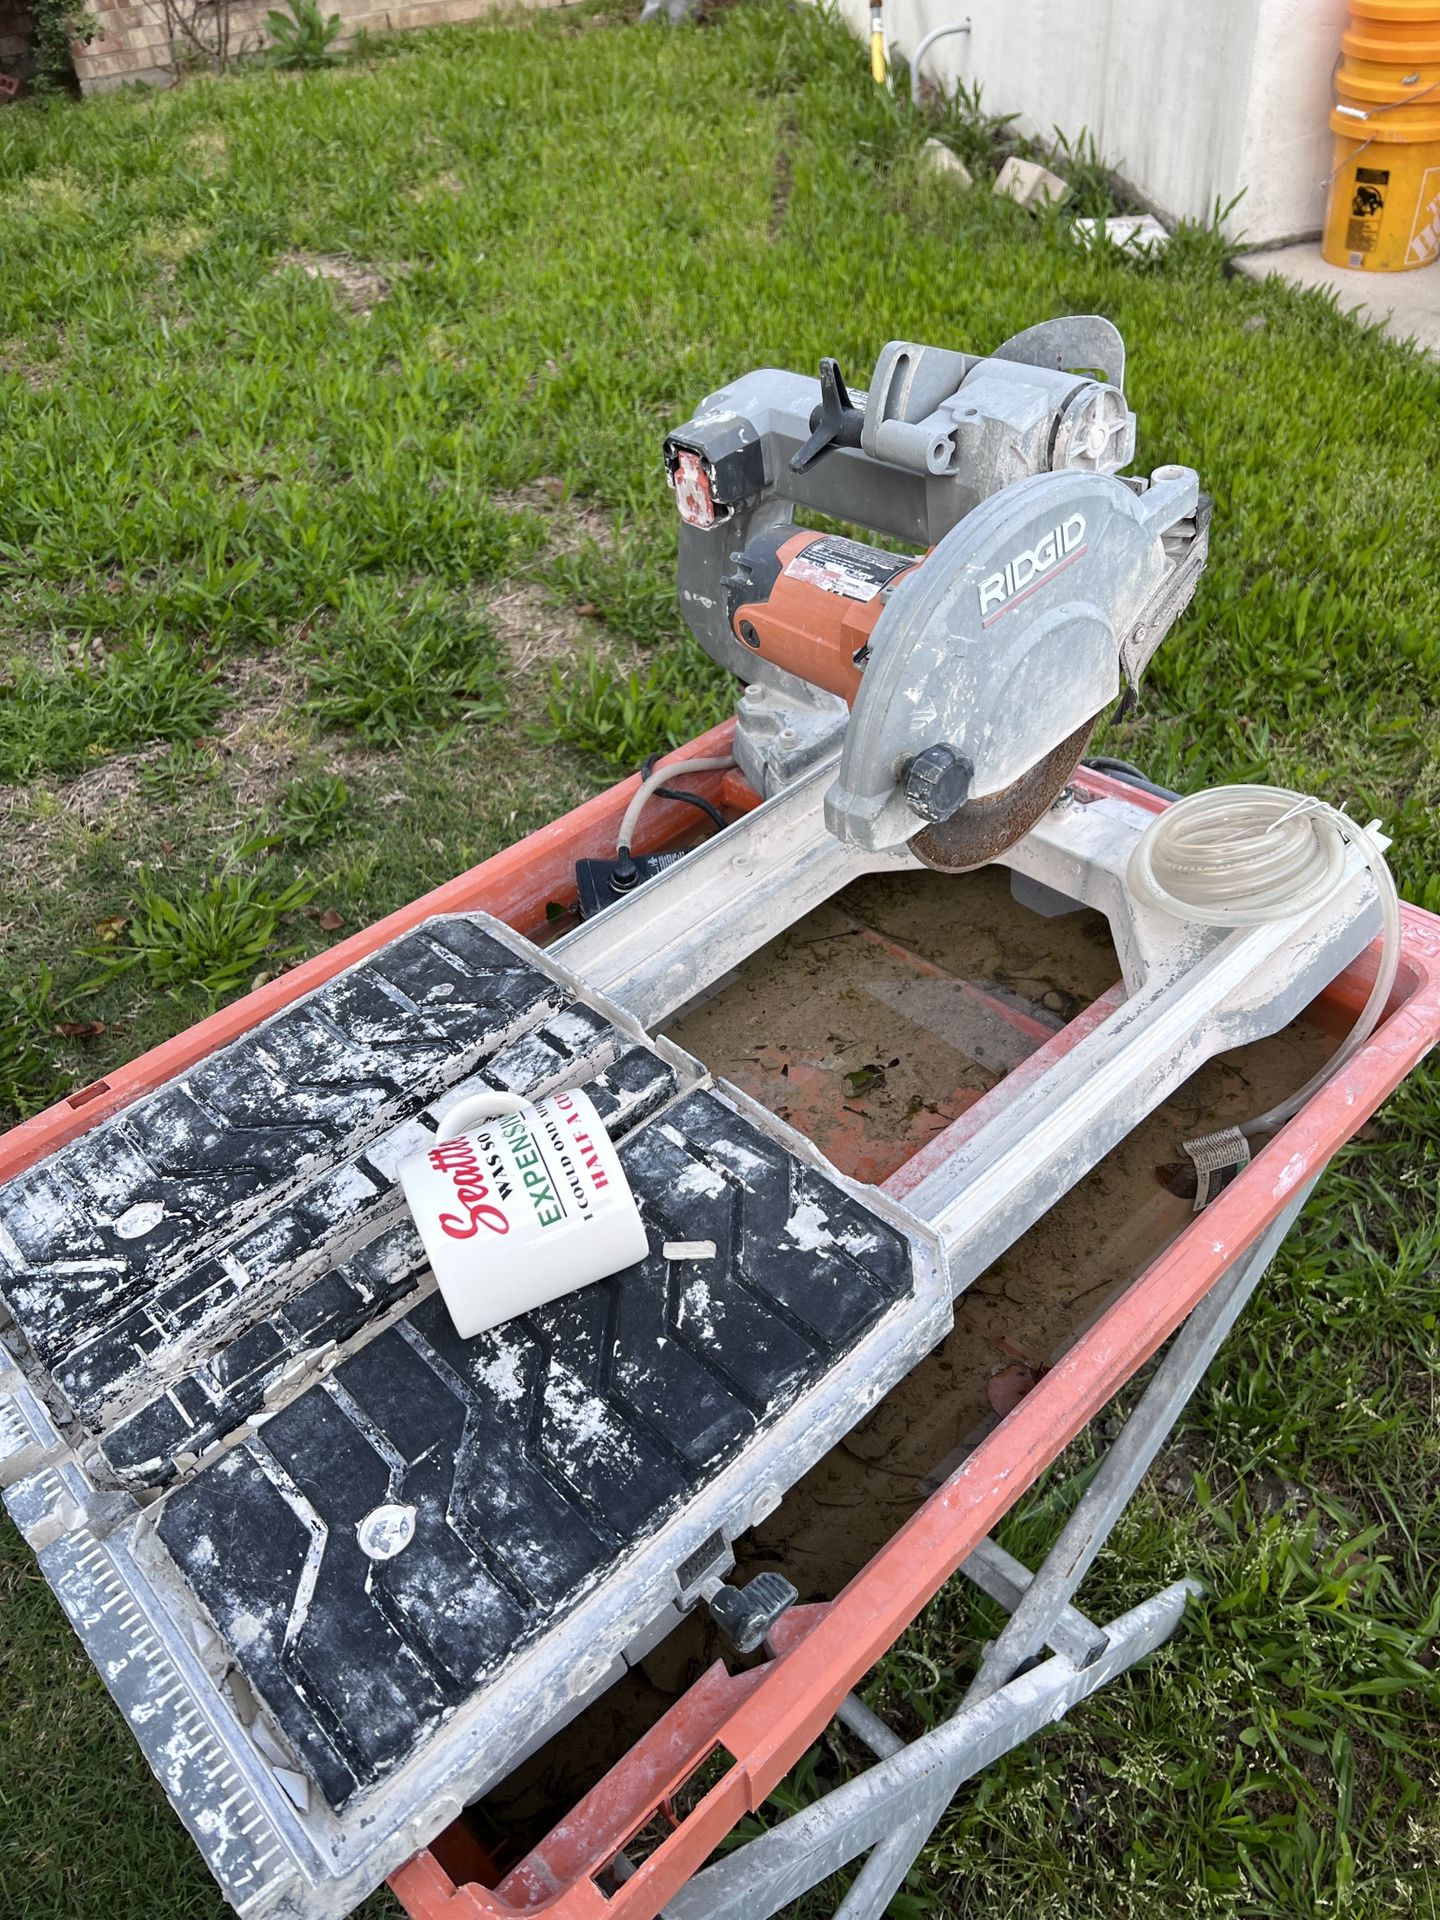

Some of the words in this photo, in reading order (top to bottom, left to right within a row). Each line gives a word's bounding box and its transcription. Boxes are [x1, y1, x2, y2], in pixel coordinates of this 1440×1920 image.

[977, 512, 1087, 616] RIDGID
[566, 1112, 582, 1125] A
[477, 1132, 495, 1151] SO
[545, 1121, 565, 1152] ONLY
[499, 1113, 562, 1228] EXPEN$IV
[573, 1131, 609, 1190] HALF
[486, 1154, 514, 1202] WAS
[560, 1155, 589, 1209] COULD
[583, 1213, 594, 1221] I
[82, 1611, 102, 1630] 2
[106, 1658, 128, 1680] 3
[233, 1869, 254, 1888] 7
